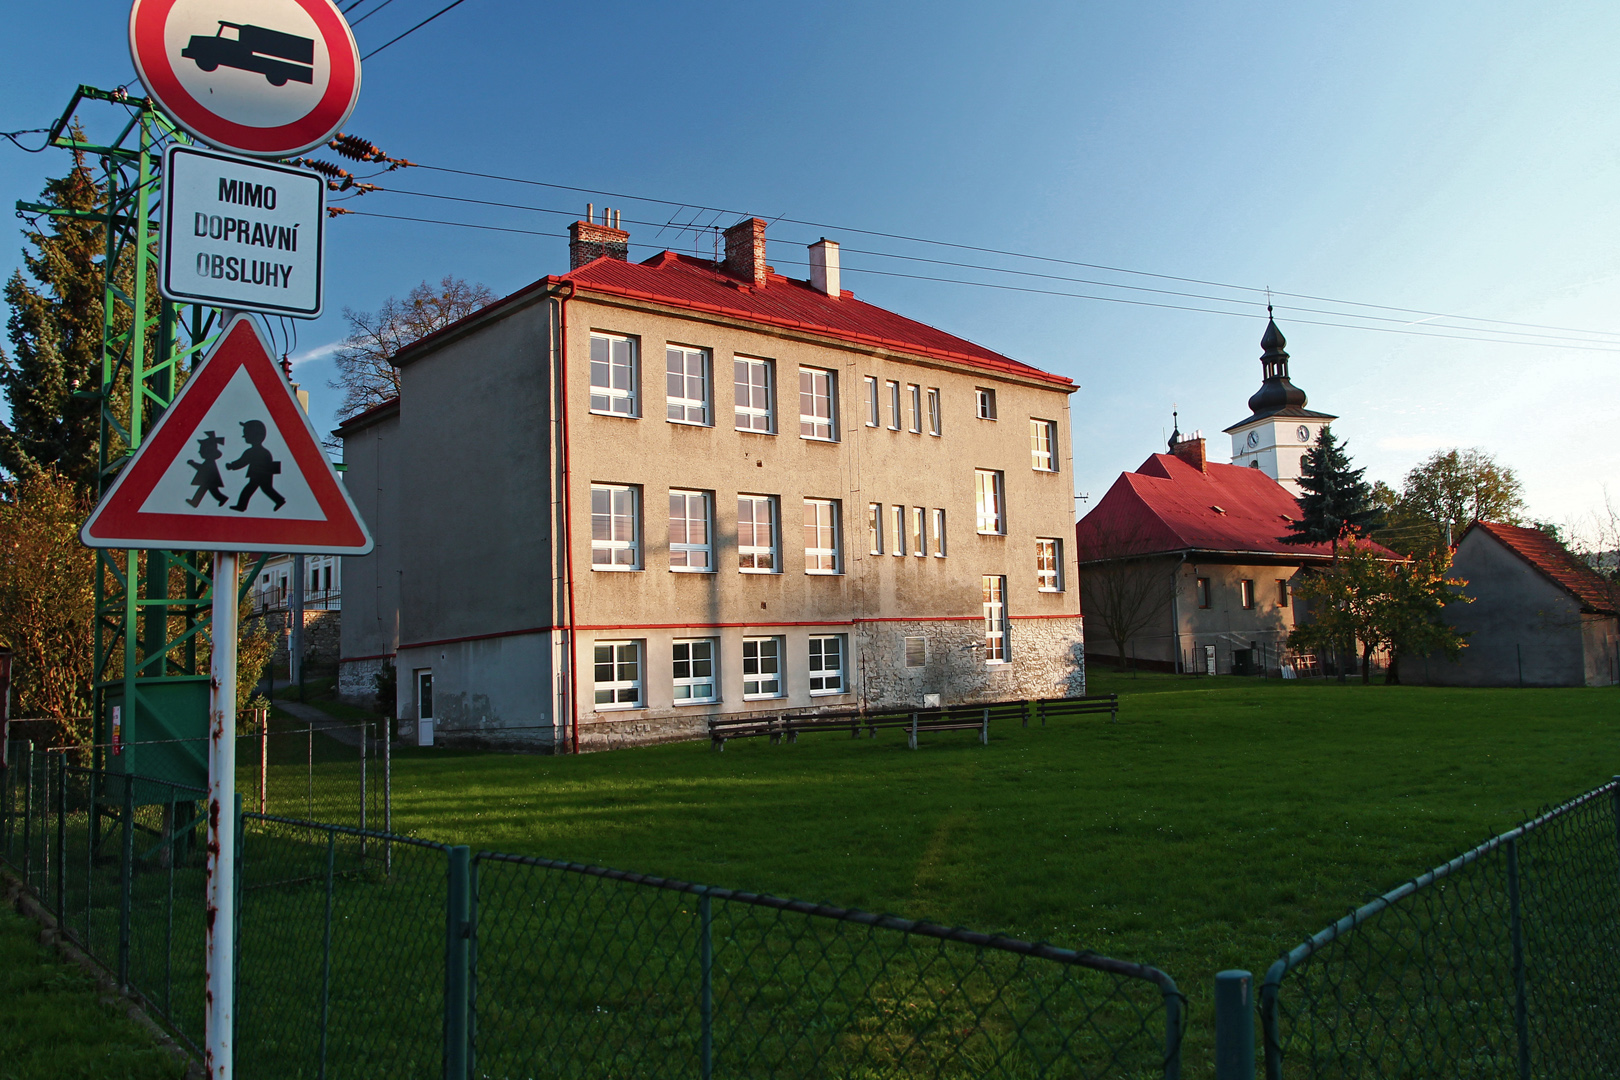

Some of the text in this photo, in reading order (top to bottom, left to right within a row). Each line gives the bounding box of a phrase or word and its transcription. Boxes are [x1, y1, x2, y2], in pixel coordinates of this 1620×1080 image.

[218, 177, 277, 210] MIMO
[194, 211, 300, 252] DOPRAVNÍ
[196, 252, 293, 289] OBSLUHY
